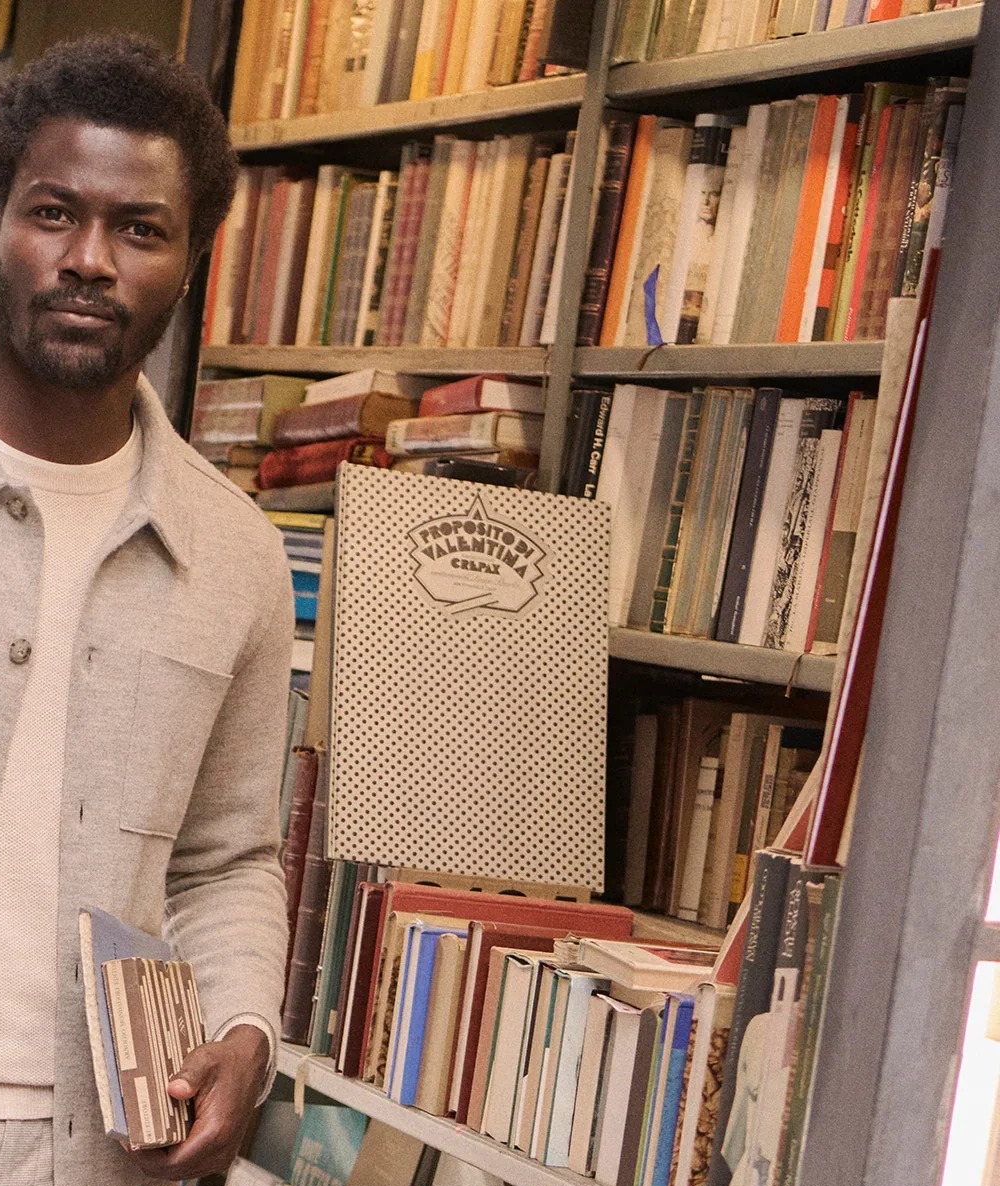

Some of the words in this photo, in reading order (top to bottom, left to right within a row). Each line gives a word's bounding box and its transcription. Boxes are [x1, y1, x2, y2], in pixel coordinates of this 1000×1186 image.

[595, 396, 611, 437] Edward
[584, 452, 600, 474] Carr
[419, 519, 515, 545] PROPOSITO
[514, 543, 536, 559] DI
[422, 534, 528, 579] VALENTINA
[451, 557, 500, 575] CREPAX
